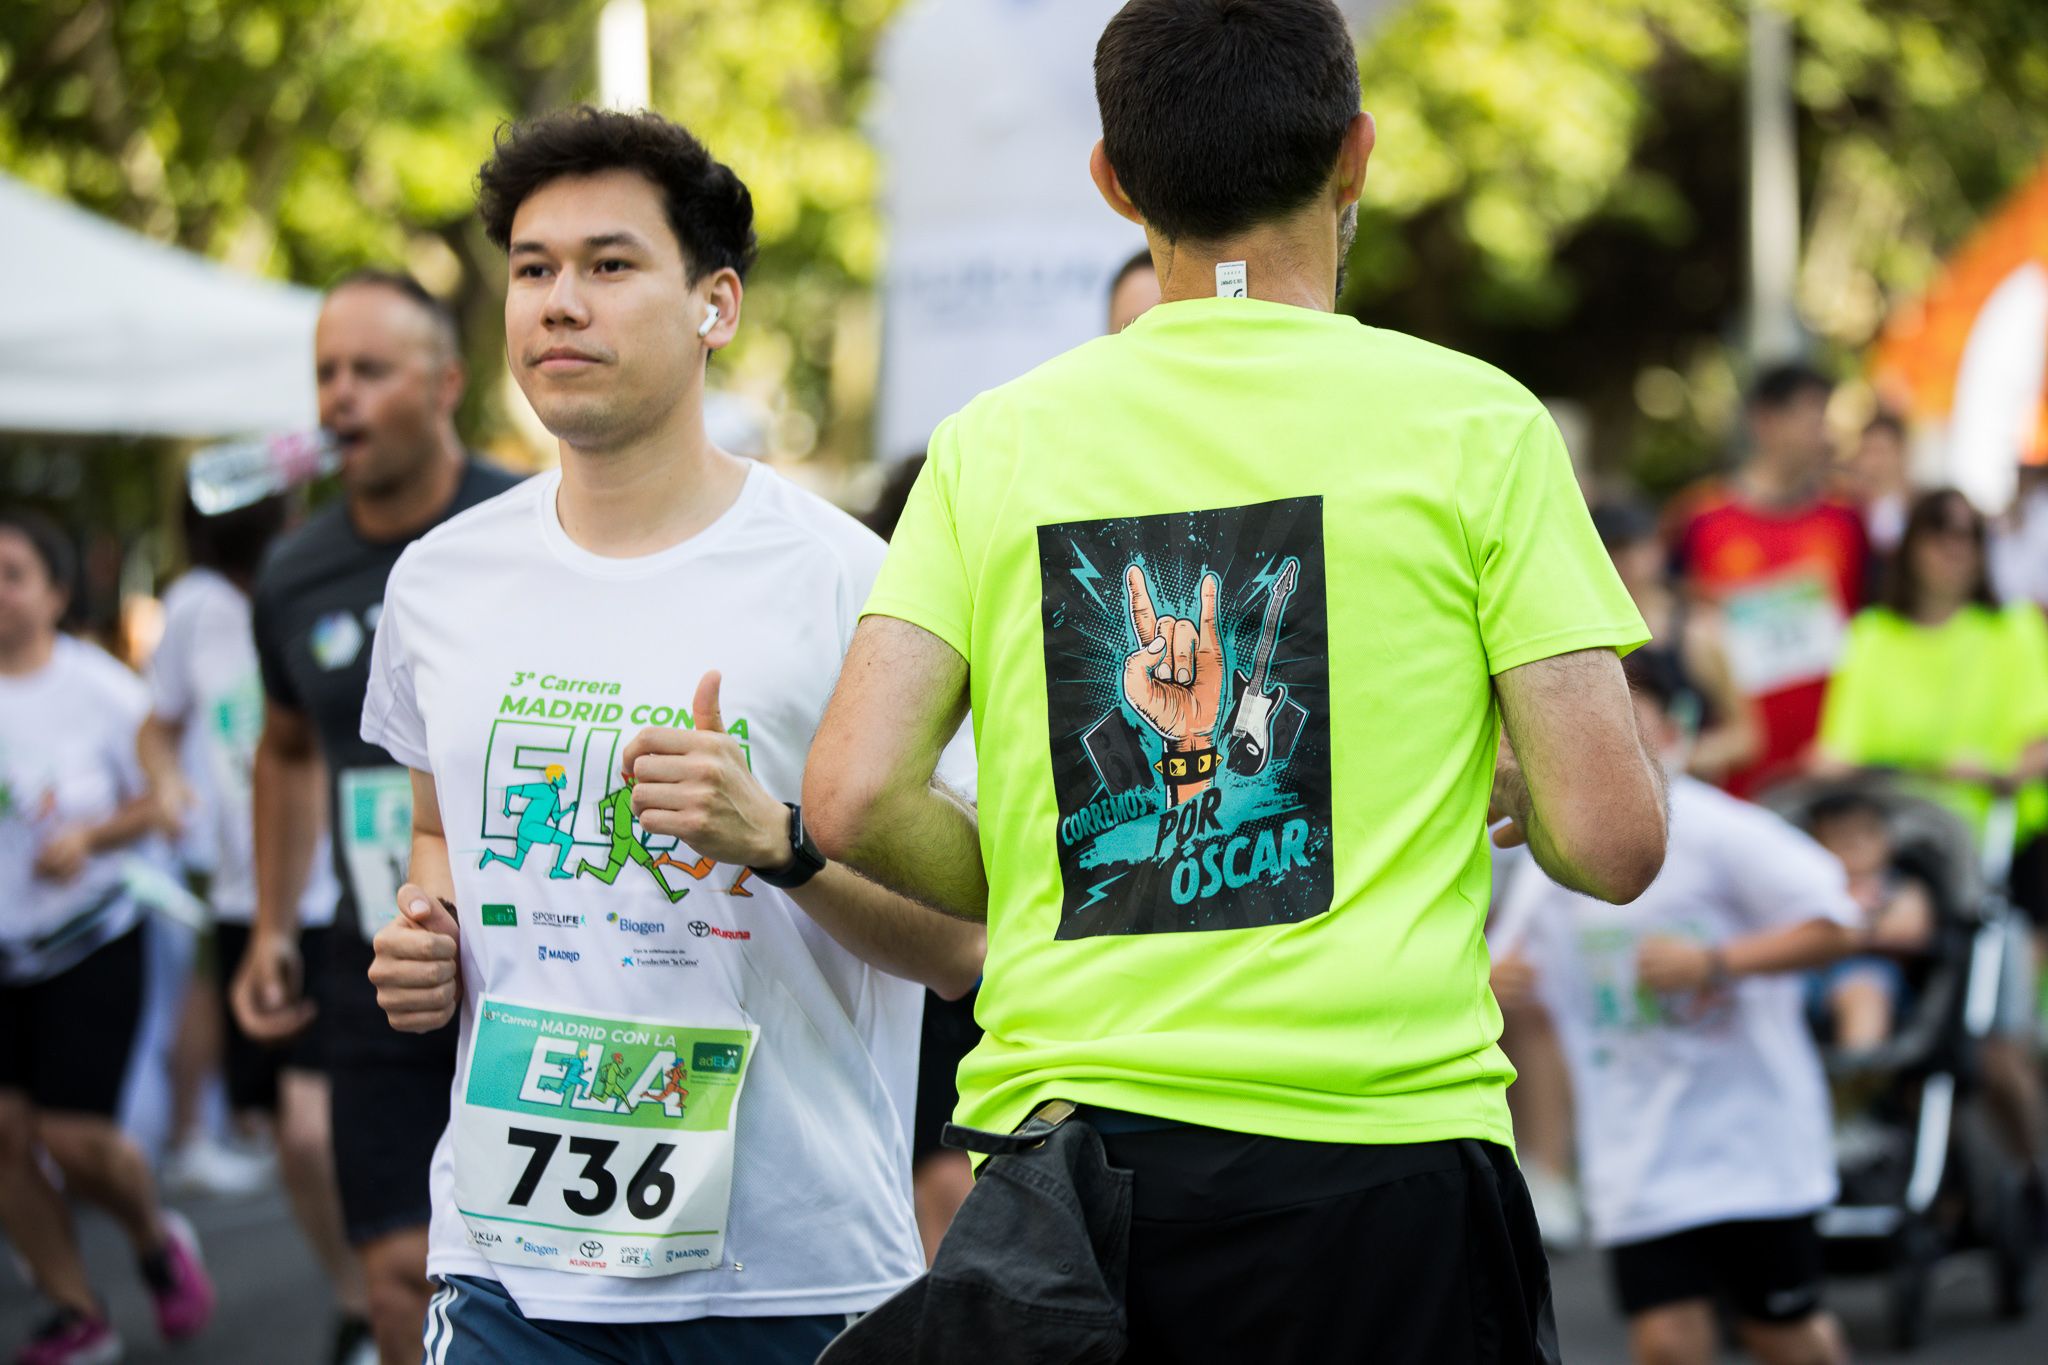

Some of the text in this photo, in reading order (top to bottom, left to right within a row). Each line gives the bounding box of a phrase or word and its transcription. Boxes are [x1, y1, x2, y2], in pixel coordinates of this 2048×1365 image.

[540, 674, 622, 695] Carrera
[499, 695, 624, 723] MADRID
[631, 705, 694, 730] CON
[1061, 786, 1223, 858] CORREMOS POR
[1170, 818, 1312, 905] ÓSCAR
[619, 918, 665, 935] Biogen
[548, 950, 580, 962] MADRID
[501, 1013, 538, 1029] Carrera
[541, 1018, 607, 1040] MADRID
[611, 1029, 650, 1046] CON
[654, 1034, 676, 1048] LA
[518, 1035, 684, 1118] ELA
[508, 1126, 678, 1220] 736
[524, 1241, 559, 1256] Biogen
[620, 1246, 644, 1256] SPORT
[675, 1248, 710, 1259] MADRID
[621, 1255, 641, 1265] LIFE
